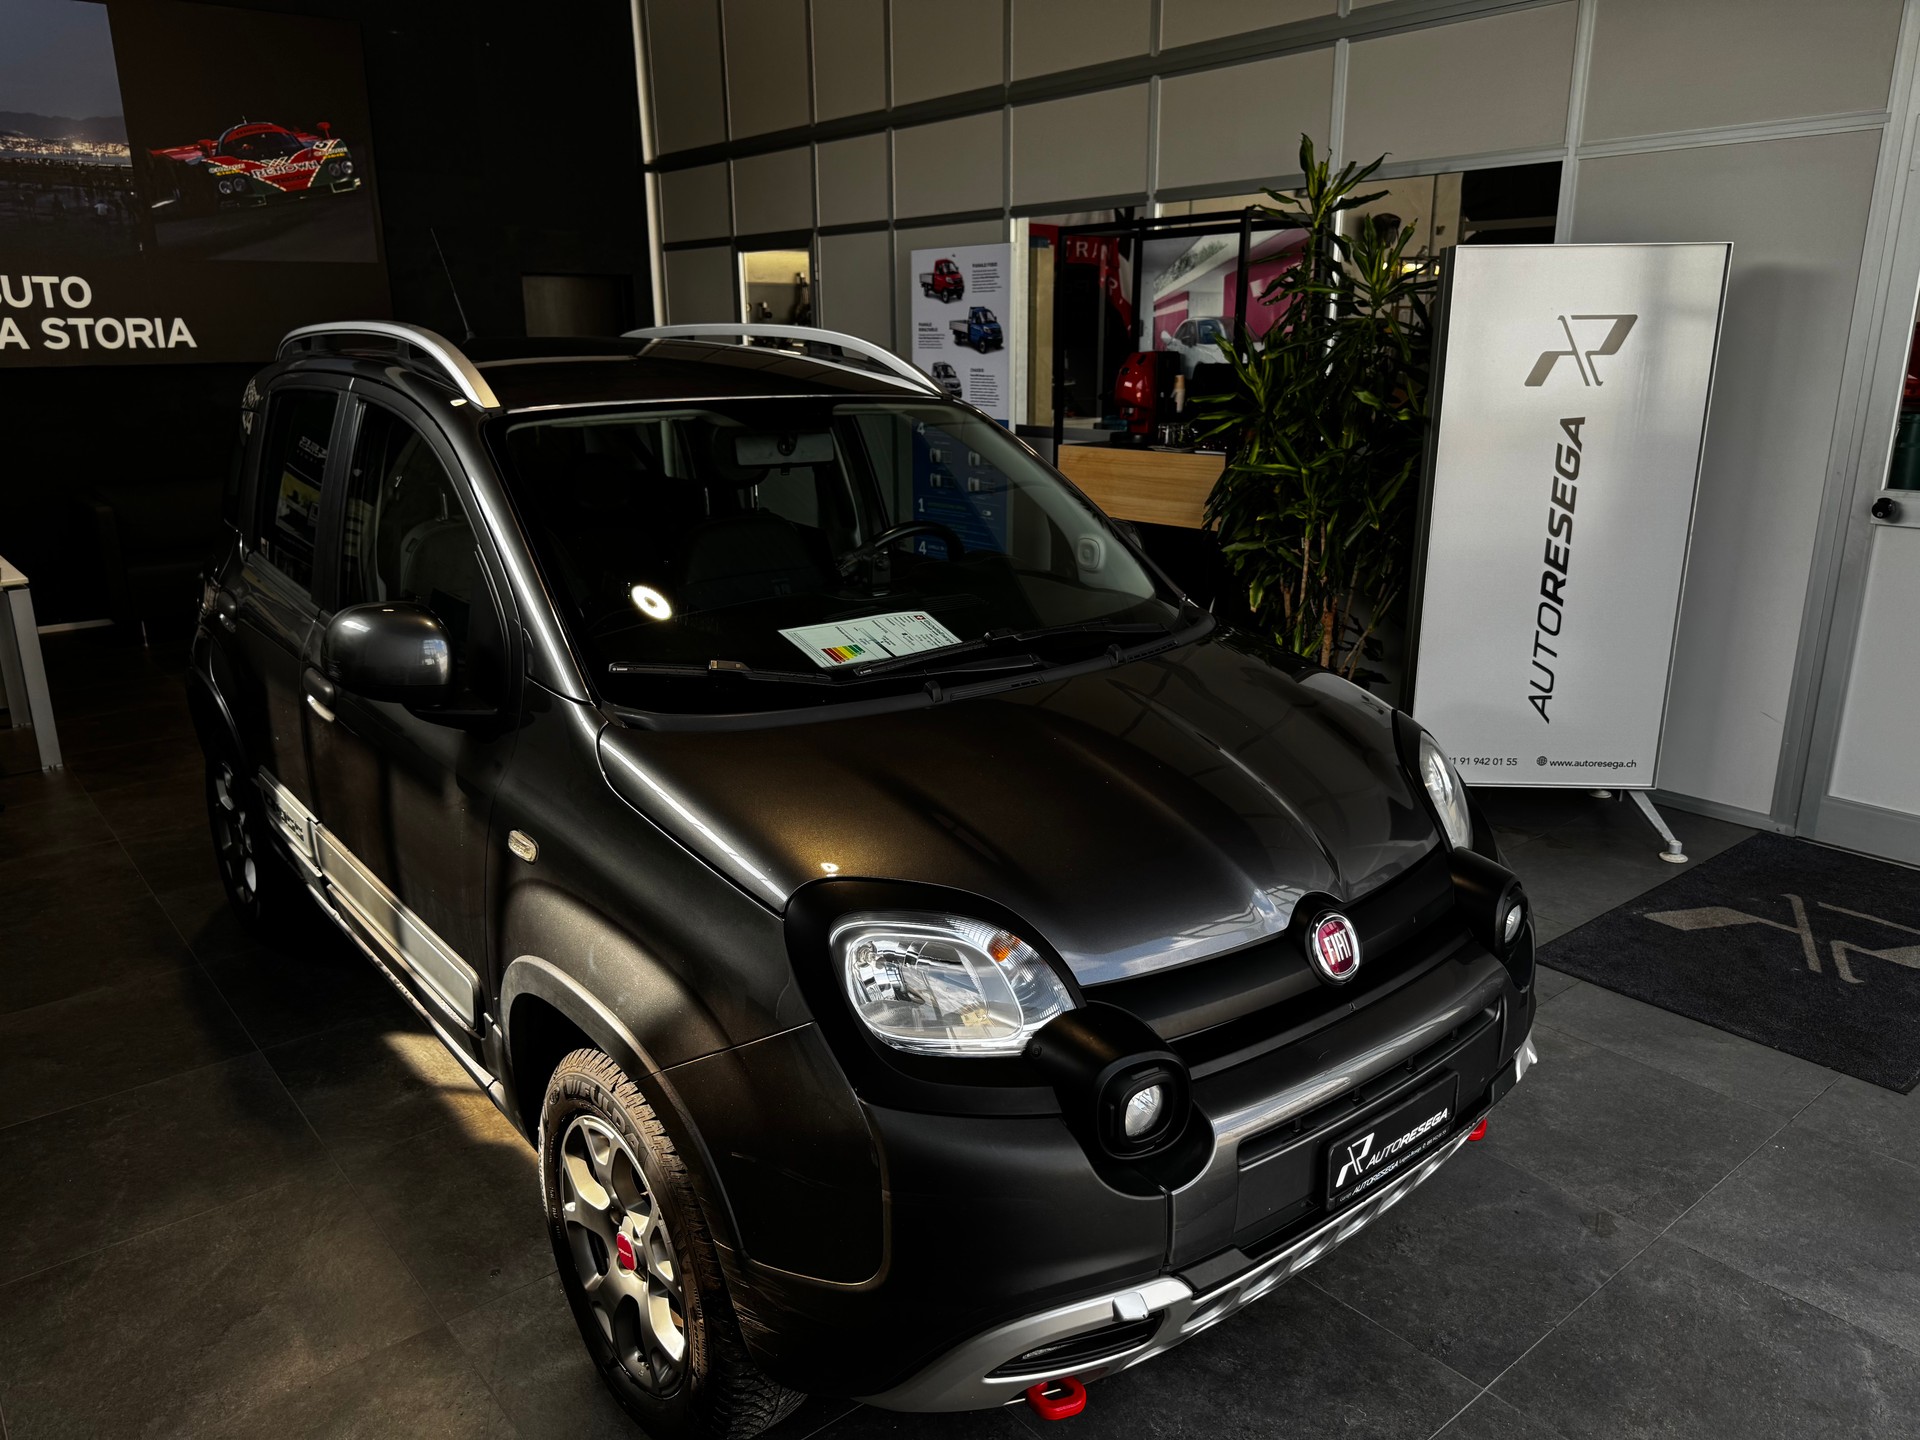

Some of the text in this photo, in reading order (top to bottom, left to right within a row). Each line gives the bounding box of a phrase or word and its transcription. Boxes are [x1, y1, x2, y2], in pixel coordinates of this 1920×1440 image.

[0, 275, 92, 309] UTO
[40, 316, 199, 350] STORIA
[1527, 416, 1586, 724] AUTORESEGA
[1459, 757, 1470, 766] 91
[1473, 757, 1491, 766] 942
[1492, 757, 1504, 766] 01
[1506, 757, 1518, 766] 55
[1549, 756, 1637, 769] www.autoresega.ch
[1322, 928, 1352, 965] FIAT
[1365, 1107, 1448, 1170] AUTORESEGA
